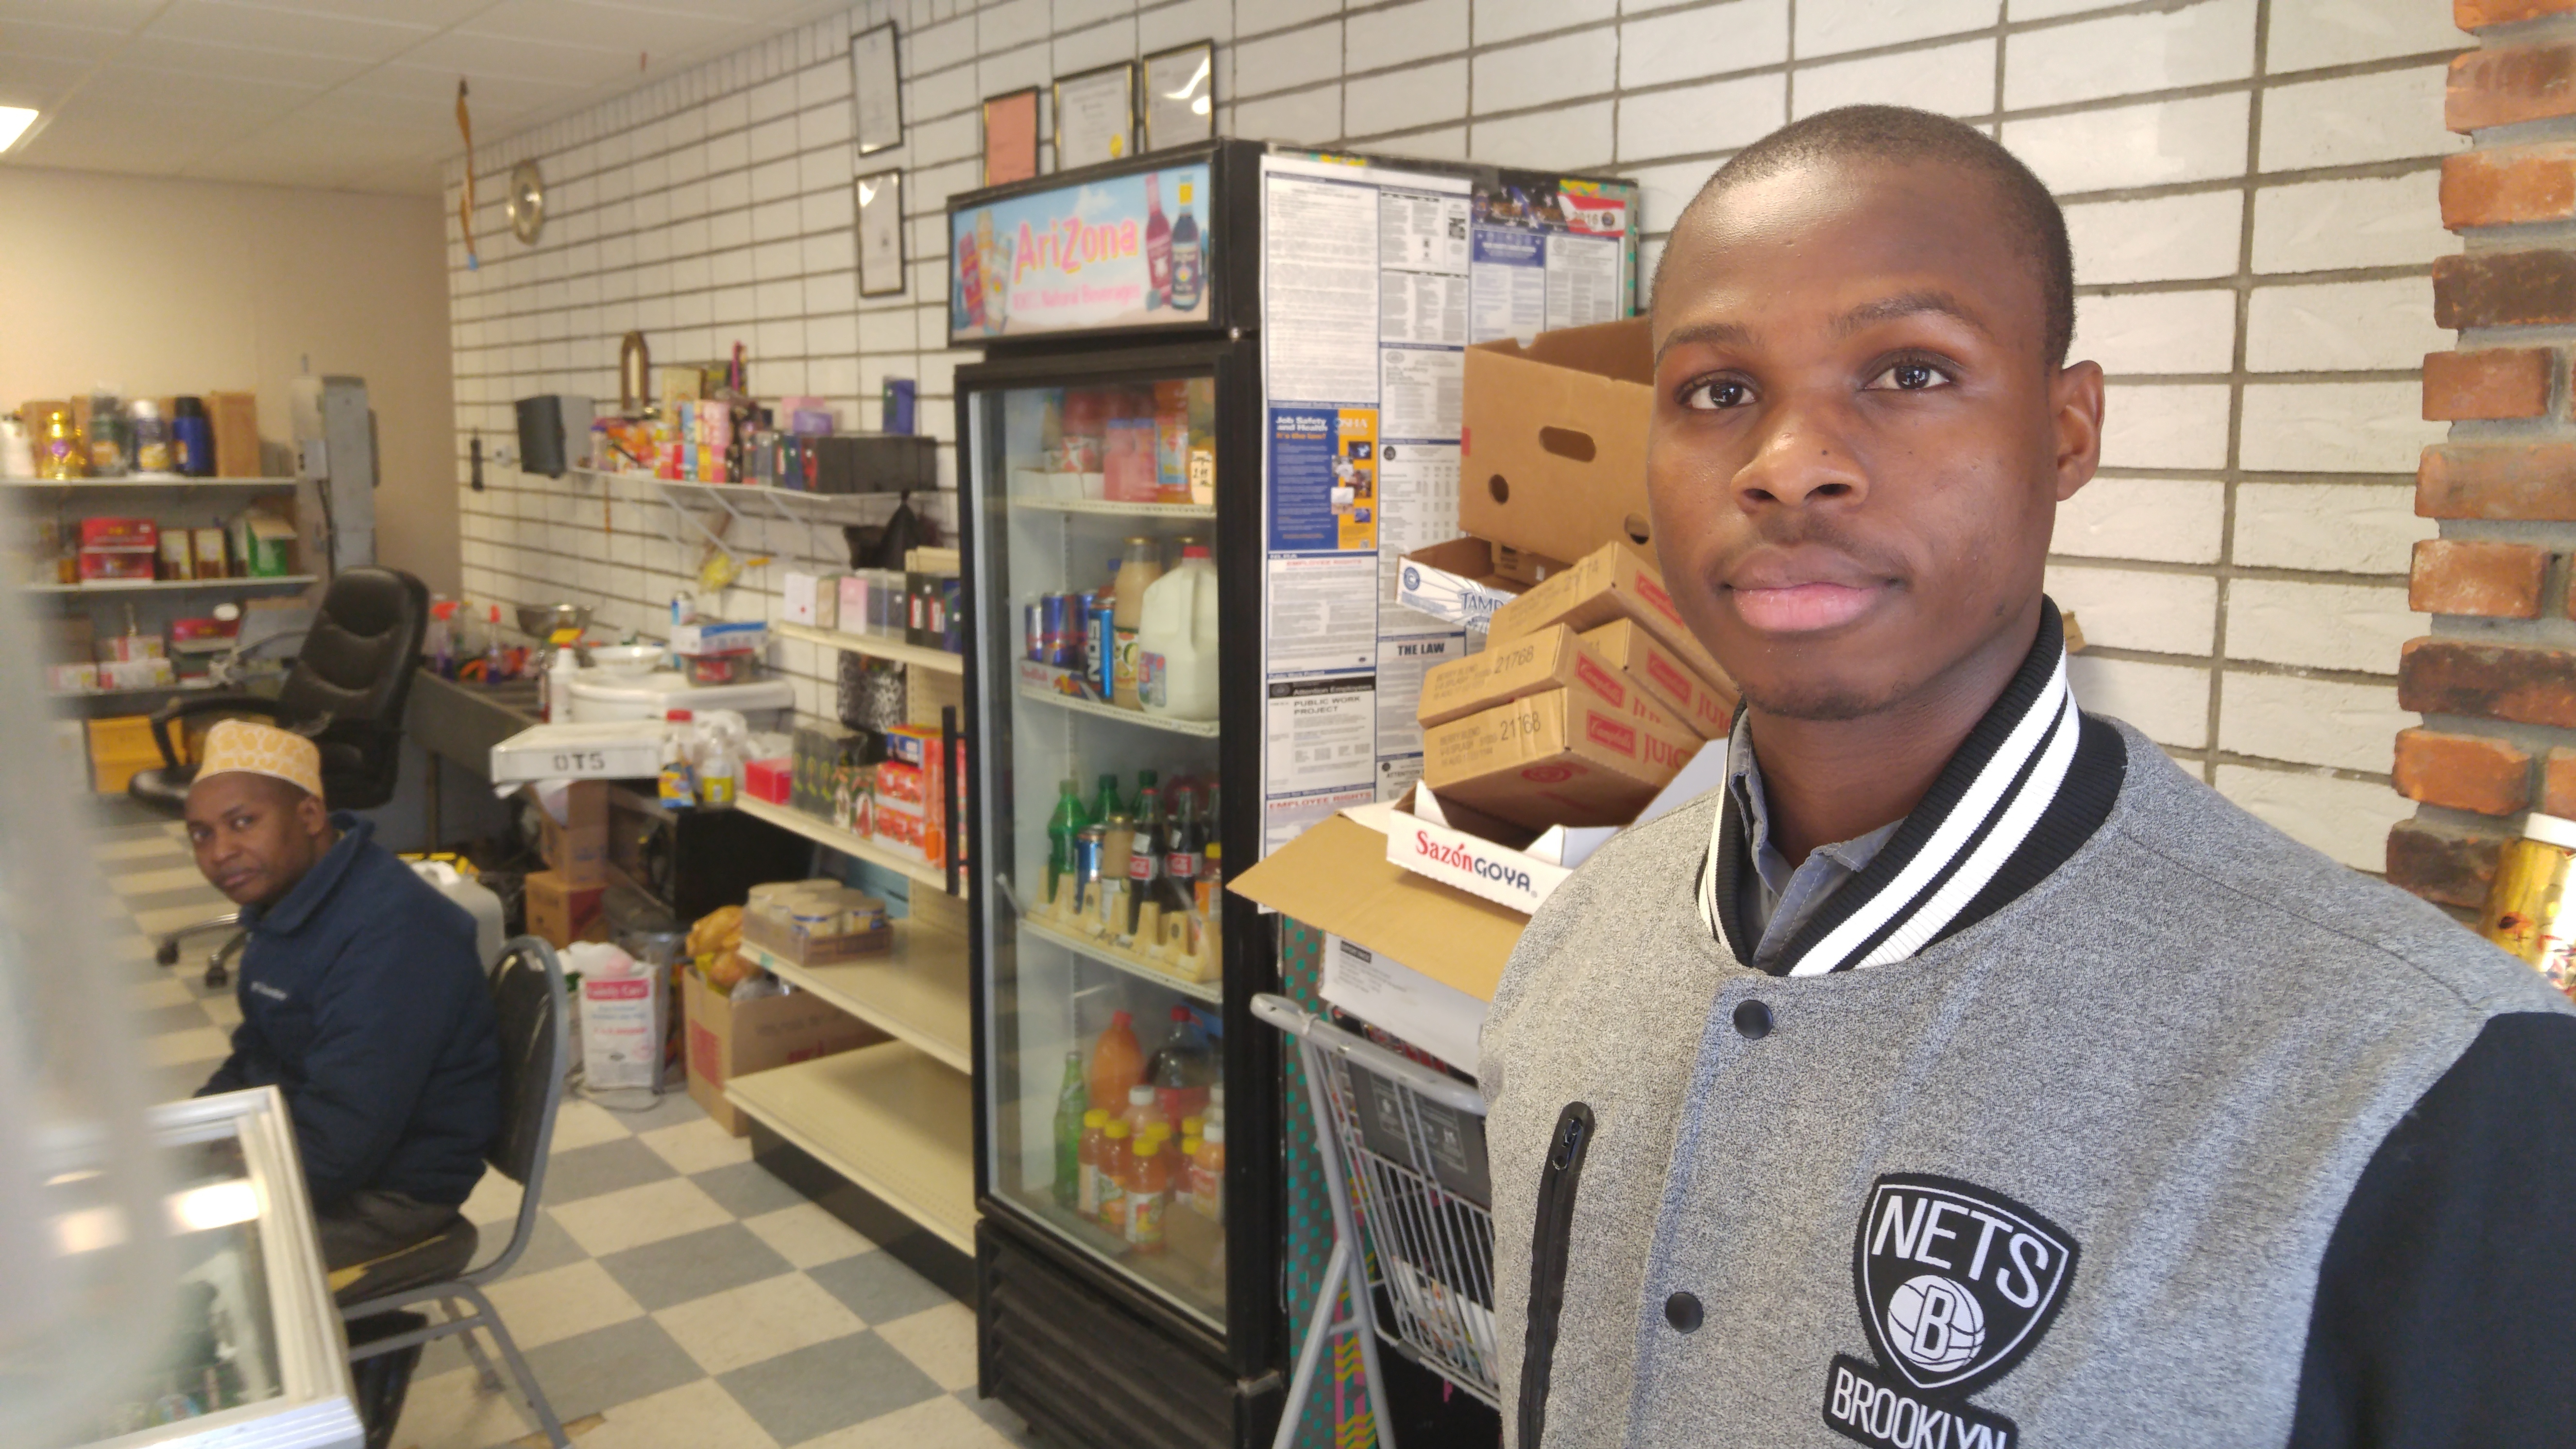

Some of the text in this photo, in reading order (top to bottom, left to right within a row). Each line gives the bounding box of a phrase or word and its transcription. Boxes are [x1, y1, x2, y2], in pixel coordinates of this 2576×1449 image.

[1014, 216, 1139, 285] AriZona
[1296, 417, 1327, 426] Safety
[1398, 643, 1445, 656] THE LAW
[1494, 646, 1534, 674] 21768
[1294, 695, 1361, 707] PUBLIC WORK
[1294, 705, 1338, 715] PROJECT
[1269, 791, 1372, 809] EMPLOYEE RIGHTS
[1416, 829, 1531, 892] Sazón GOYA
[1871, 1195, 2049, 1308] NETS
[1912, 1285, 1957, 1360] B
[1830, 1365, 2007, 1449] BROOKLYN
